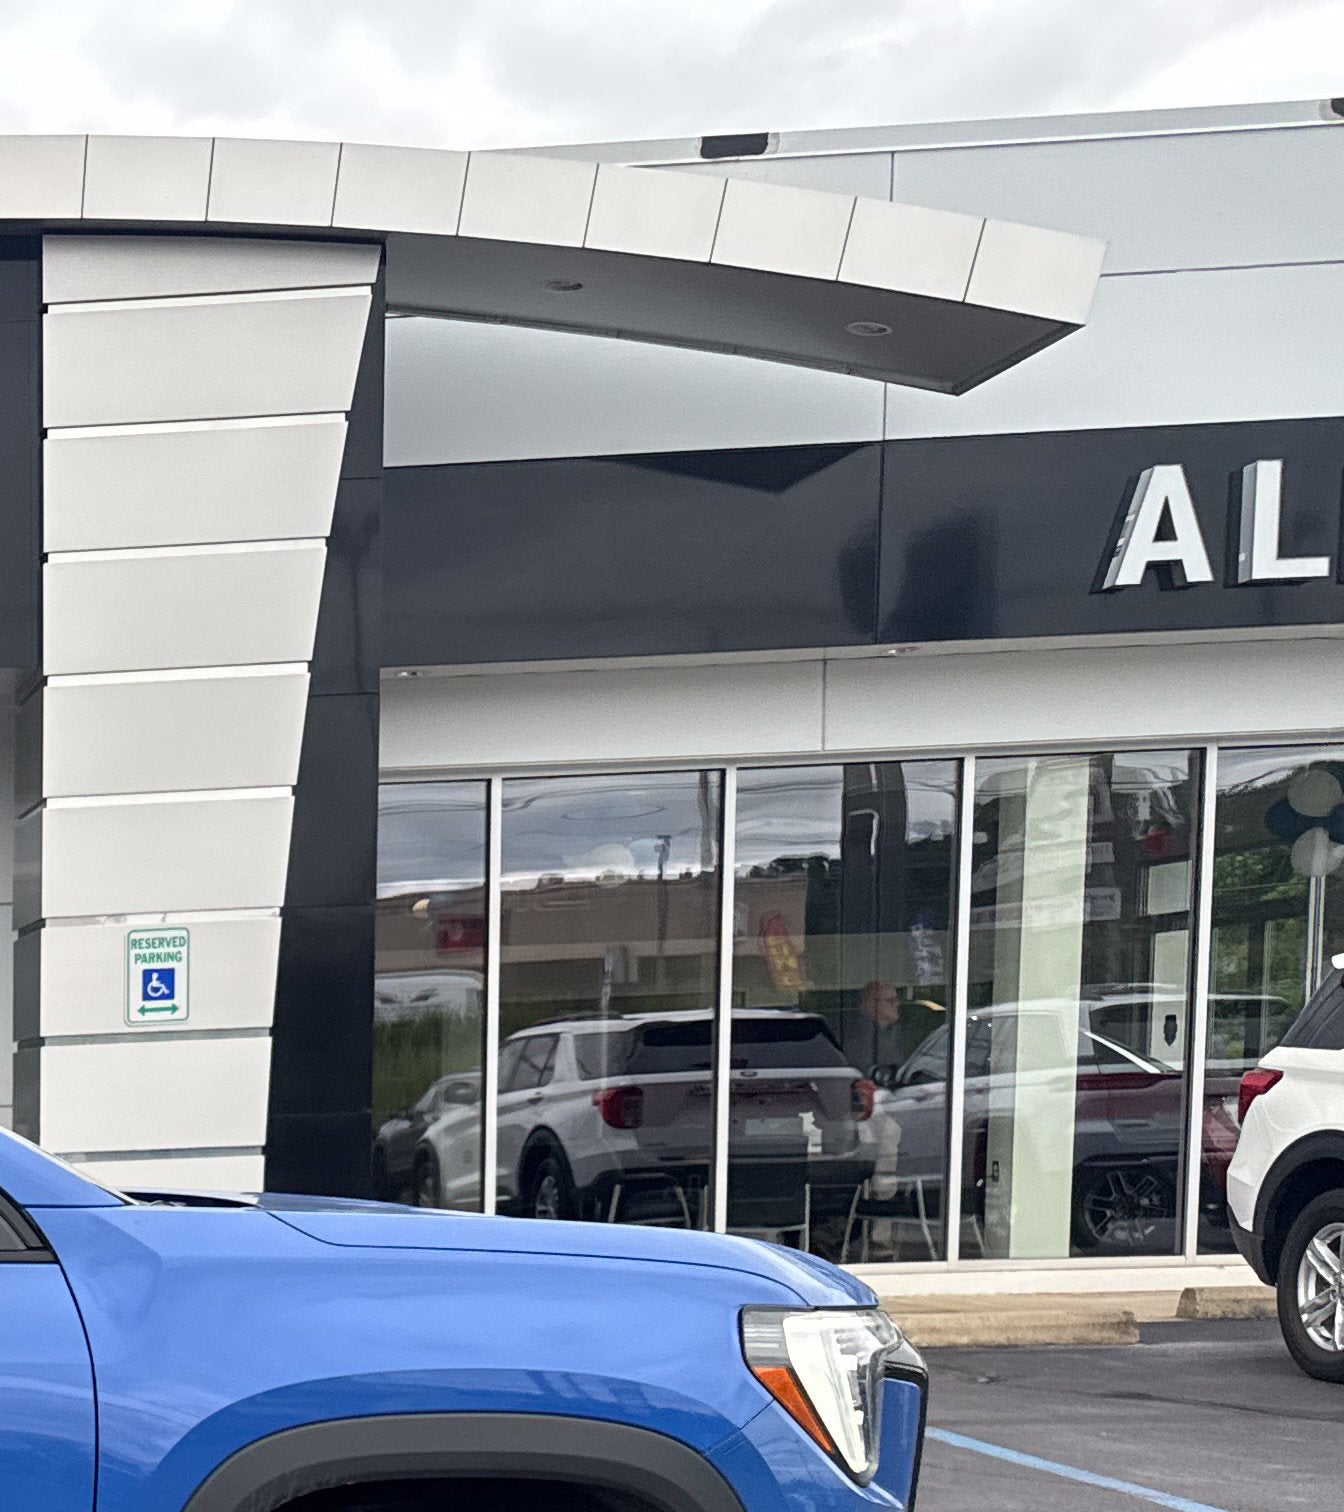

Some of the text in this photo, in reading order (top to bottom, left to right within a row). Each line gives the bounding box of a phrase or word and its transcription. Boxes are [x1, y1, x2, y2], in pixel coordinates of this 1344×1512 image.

[1103, 458, 1331, 590] AL
[131, 936, 187, 950] RESERVED
[134, 951, 183, 965] PARKING
